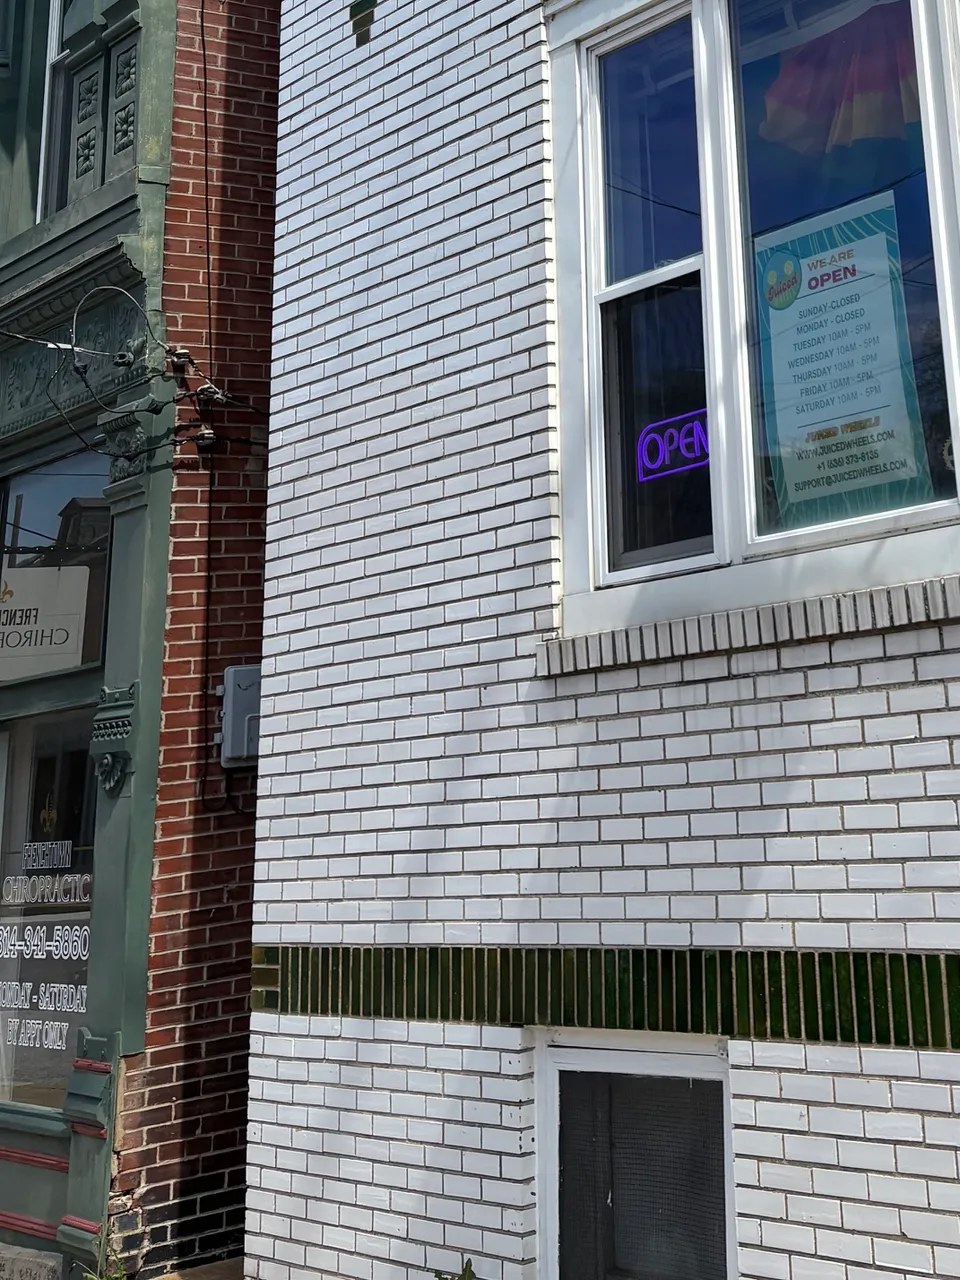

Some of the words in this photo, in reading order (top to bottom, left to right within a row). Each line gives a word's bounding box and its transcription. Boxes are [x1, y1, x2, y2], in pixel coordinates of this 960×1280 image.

[807, 258, 827, 272] WE
[829, 249, 854, 265] ARE
[768, 275, 798, 302] Juiced
[807, 264, 857, 290] OPEN
[793, 335, 827, 352] TUESDAY
[828, 328, 849, 342] 10AM
[855, 322, 871, 335] 5PM
[796, 319, 828, 336] MONDAY
[834, 308, 865, 324] CLOSED
[787, 349, 834, 369] WEDNESDAY
[836, 342, 857, 356] 10AM
[863, 335, 880, 348] 5PM
[792, 365, 832, 384] THURSDAY
[834, 359, 854, 372] 10AM
[861, 353, 878, 366] 5PM
[800, 383, 828, 398] FRIDAY
[829, 376, 850, 389] 10AM
[857, 370, 873, 383] 5PM
[795, 397, 835, 415] SATURDAY
[837, 391, 858, 404] 10AM
[865, 385, 882, 397] 5PM
[642, 420, 709, 470] OPEN
[796, 430, 895, 460] WWW.JUICEDWHEELS.COM
[794, 458, 907, 492] SUPPORT@JUICEDWHEELS.COM
[817, 463, 826, 472] +1
[2, 873, 91, 903] CHIROPRACTIC
[0, 981, 32, 1008] ONDAY
[38, 983, 87, 1013] SATURDAY
[7, 1018, 19, 1045] BY
[19, 1019, 42, 1047] APPT
[43, 1021, 69, 1050] ONLY
